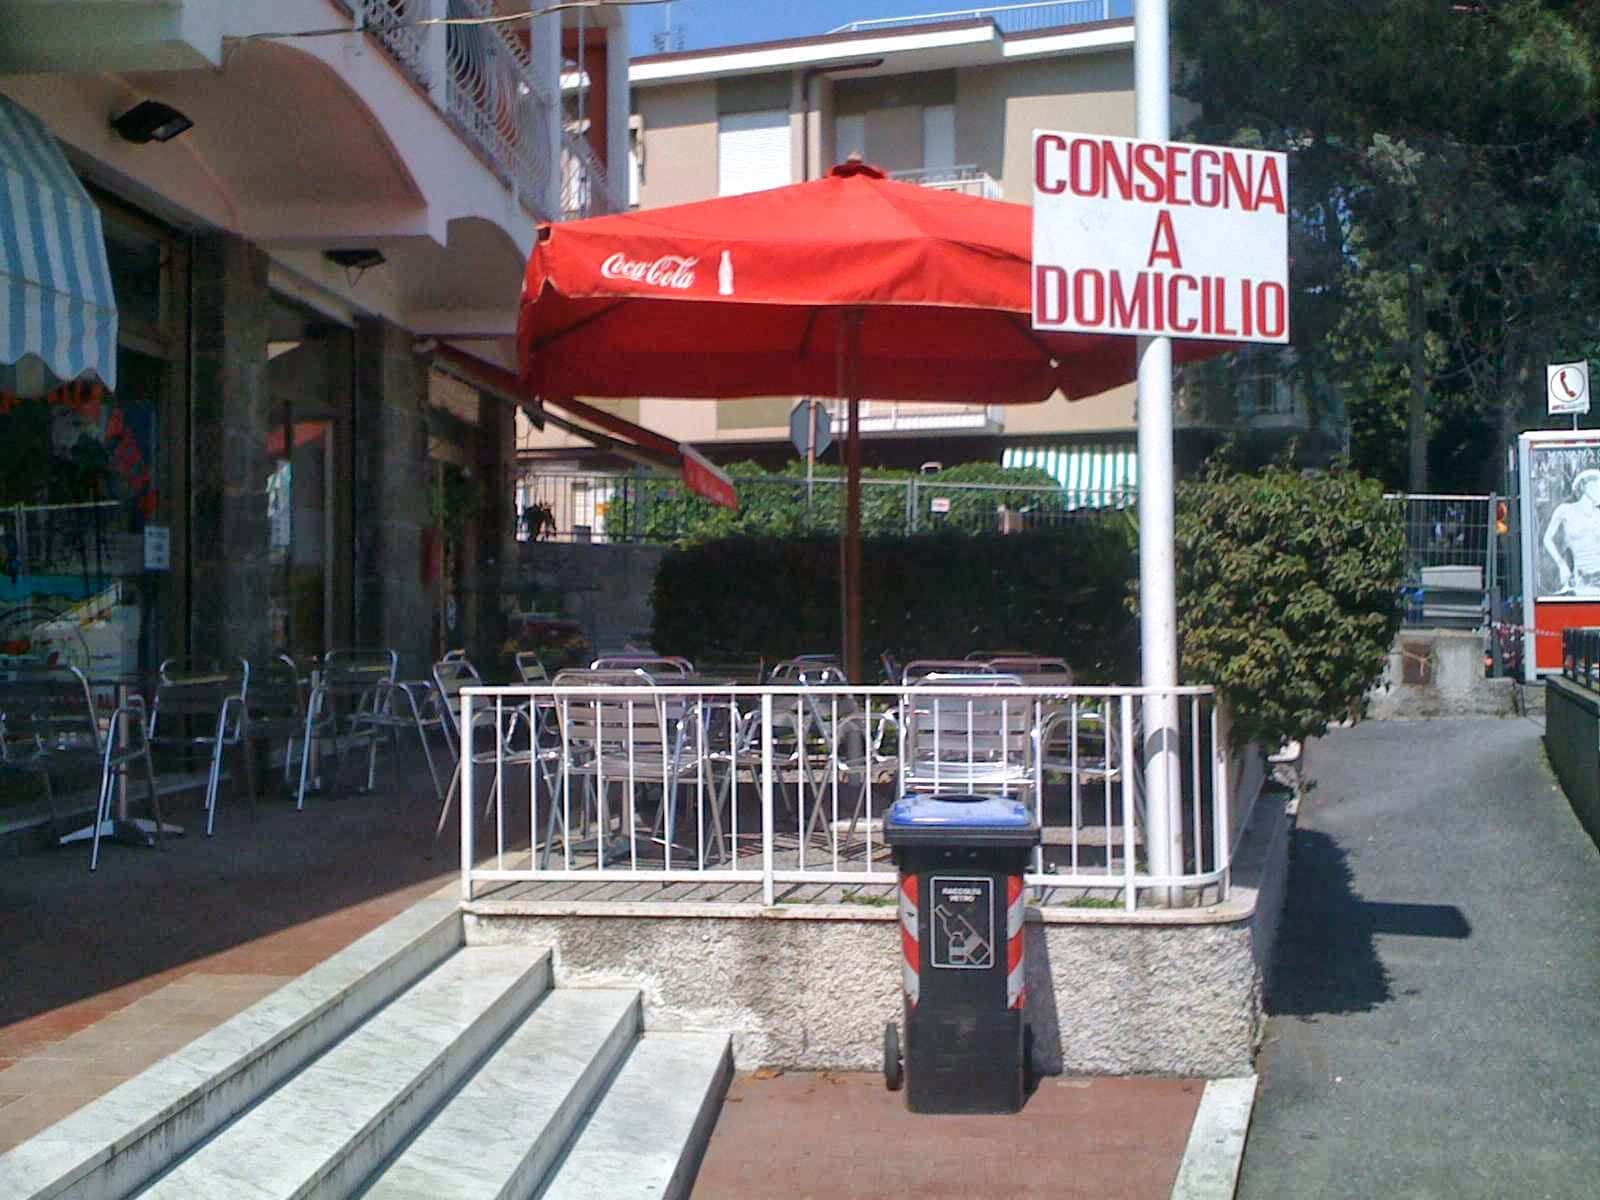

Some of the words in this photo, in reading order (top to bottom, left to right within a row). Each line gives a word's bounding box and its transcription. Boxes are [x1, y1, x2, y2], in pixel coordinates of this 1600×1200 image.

[1035, 134, 1285, 214] CONSEGNA
[601, 252, 700, 289] Coca-Cola
[1147, 210, 1182, 269] A
[1035, 265, 1285, 338] DOMICILIO
